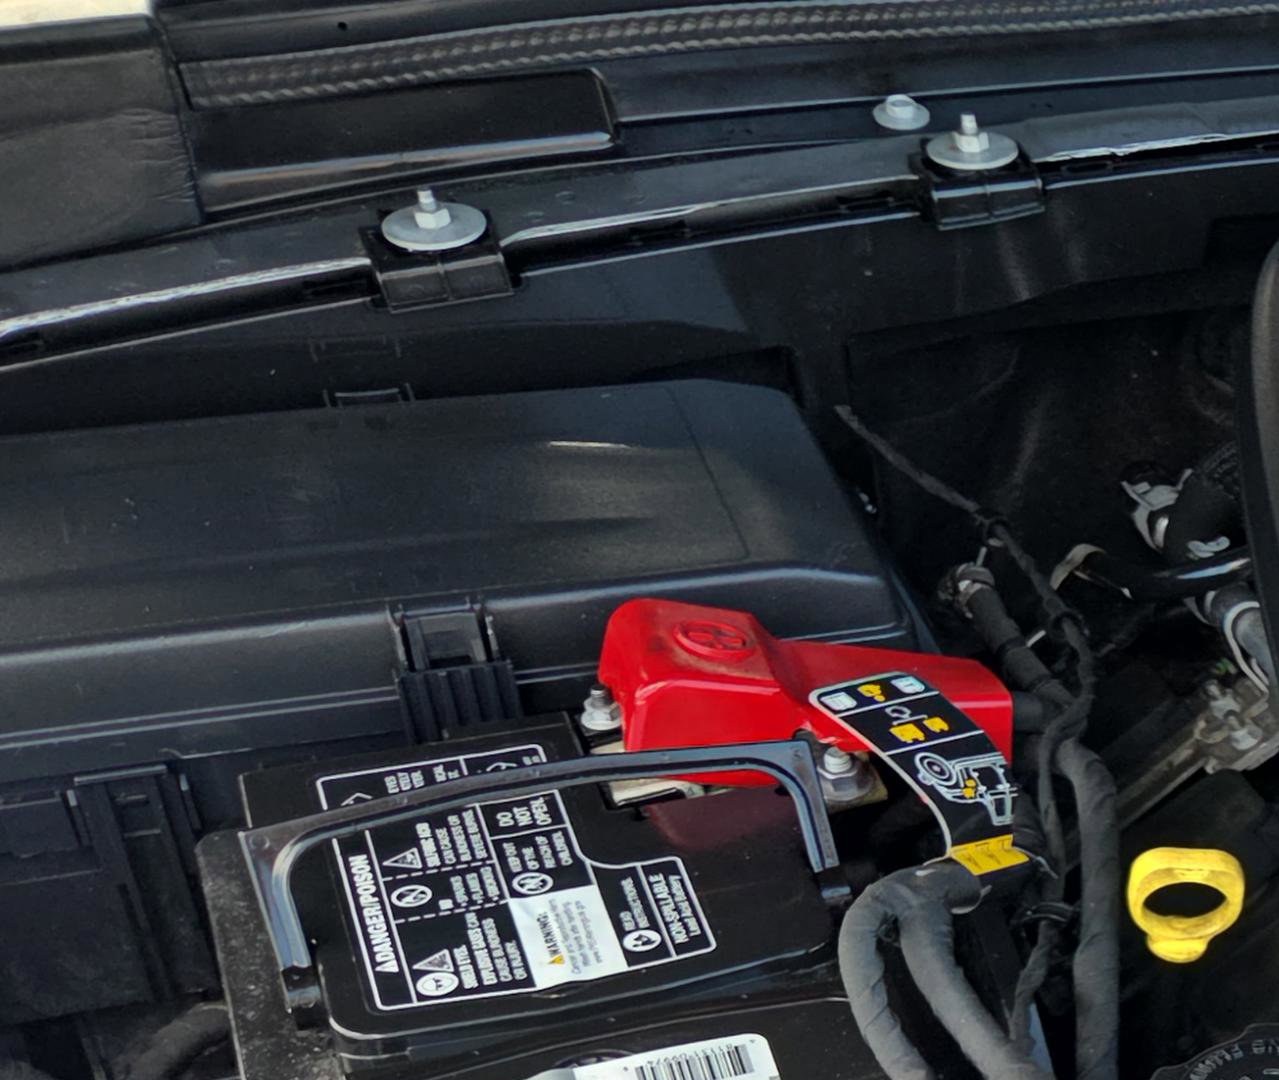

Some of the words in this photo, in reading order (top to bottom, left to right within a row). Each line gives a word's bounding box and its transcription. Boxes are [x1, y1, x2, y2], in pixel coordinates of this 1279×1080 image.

[495, 811, 514, 827] DO
[512, 806, 533, 826] NOT
[529, 797, 552, 825] OPEN.
[349, 854, 394, 962] DANGER/POISON
[648, 873, 688, 943] NON-SPILLABLE
